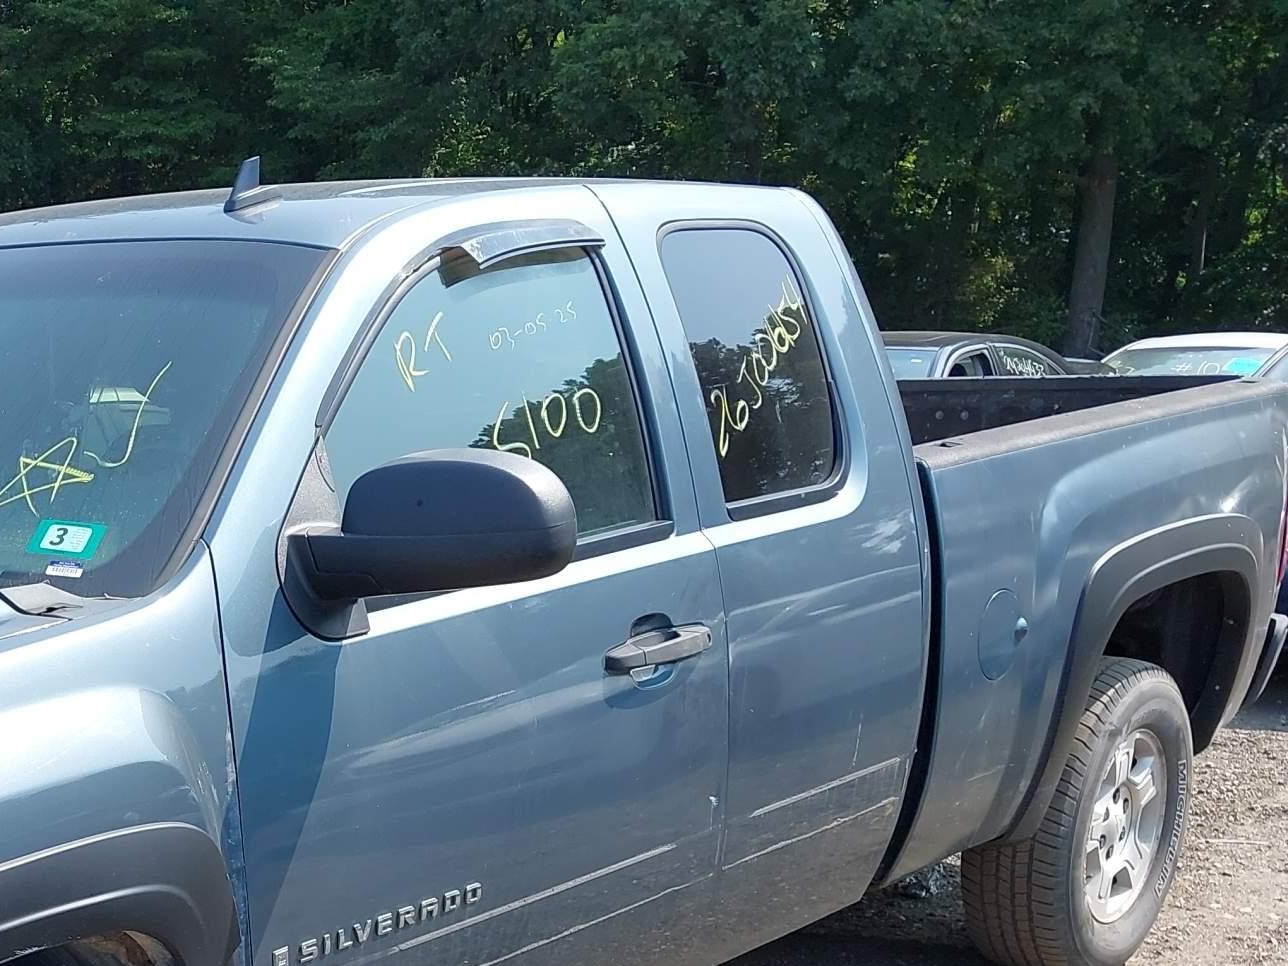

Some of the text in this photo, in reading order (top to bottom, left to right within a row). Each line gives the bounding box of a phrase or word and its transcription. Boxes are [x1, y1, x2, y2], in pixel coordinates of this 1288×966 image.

[392, 310, 453, 393] RT
[48, 526, 70, 547] 3
[1154, 758, 1188, 900] MICHELIN
[298, 880, 484, 966] SILVERADO
